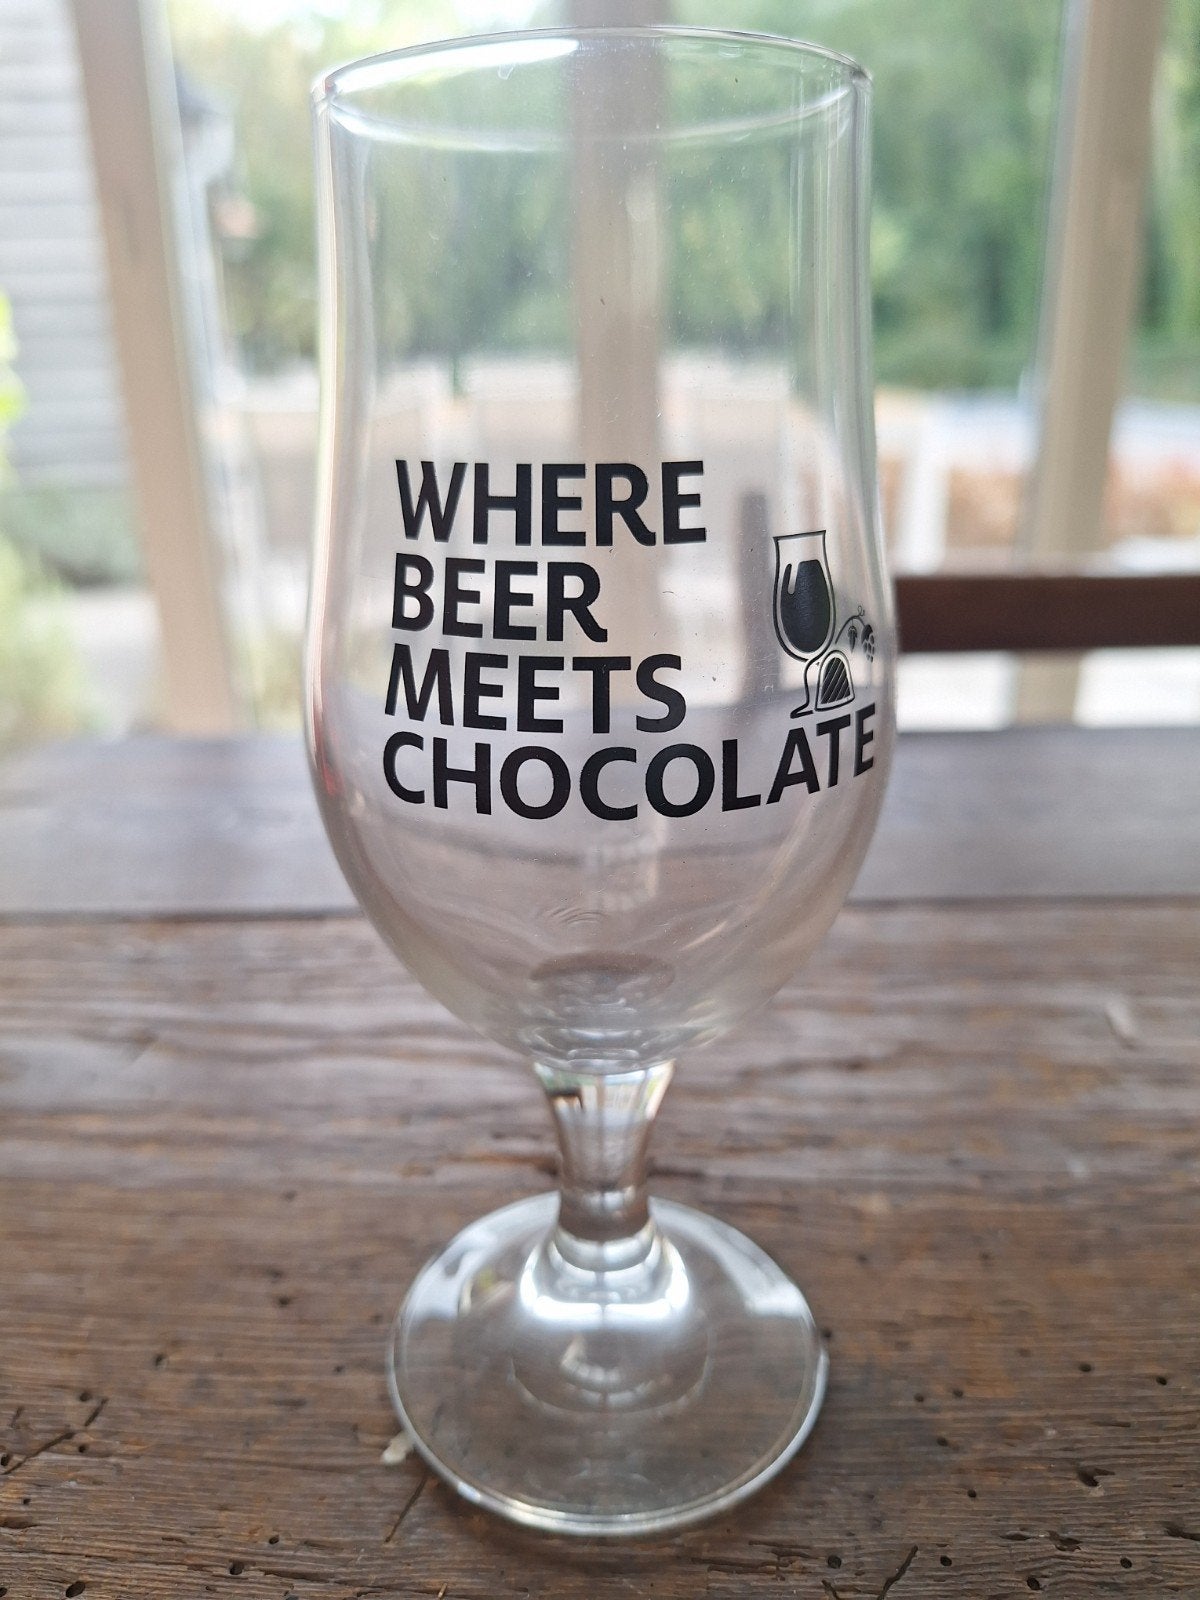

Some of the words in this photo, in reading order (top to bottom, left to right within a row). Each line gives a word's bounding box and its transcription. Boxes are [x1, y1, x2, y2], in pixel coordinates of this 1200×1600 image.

[395, 459, 707, 547] WHERE
[391, 552, 608, 643] BEER
[384, 642, 687, 734] MEETS
[382, 702, 877, 822] CHOCOLATE
